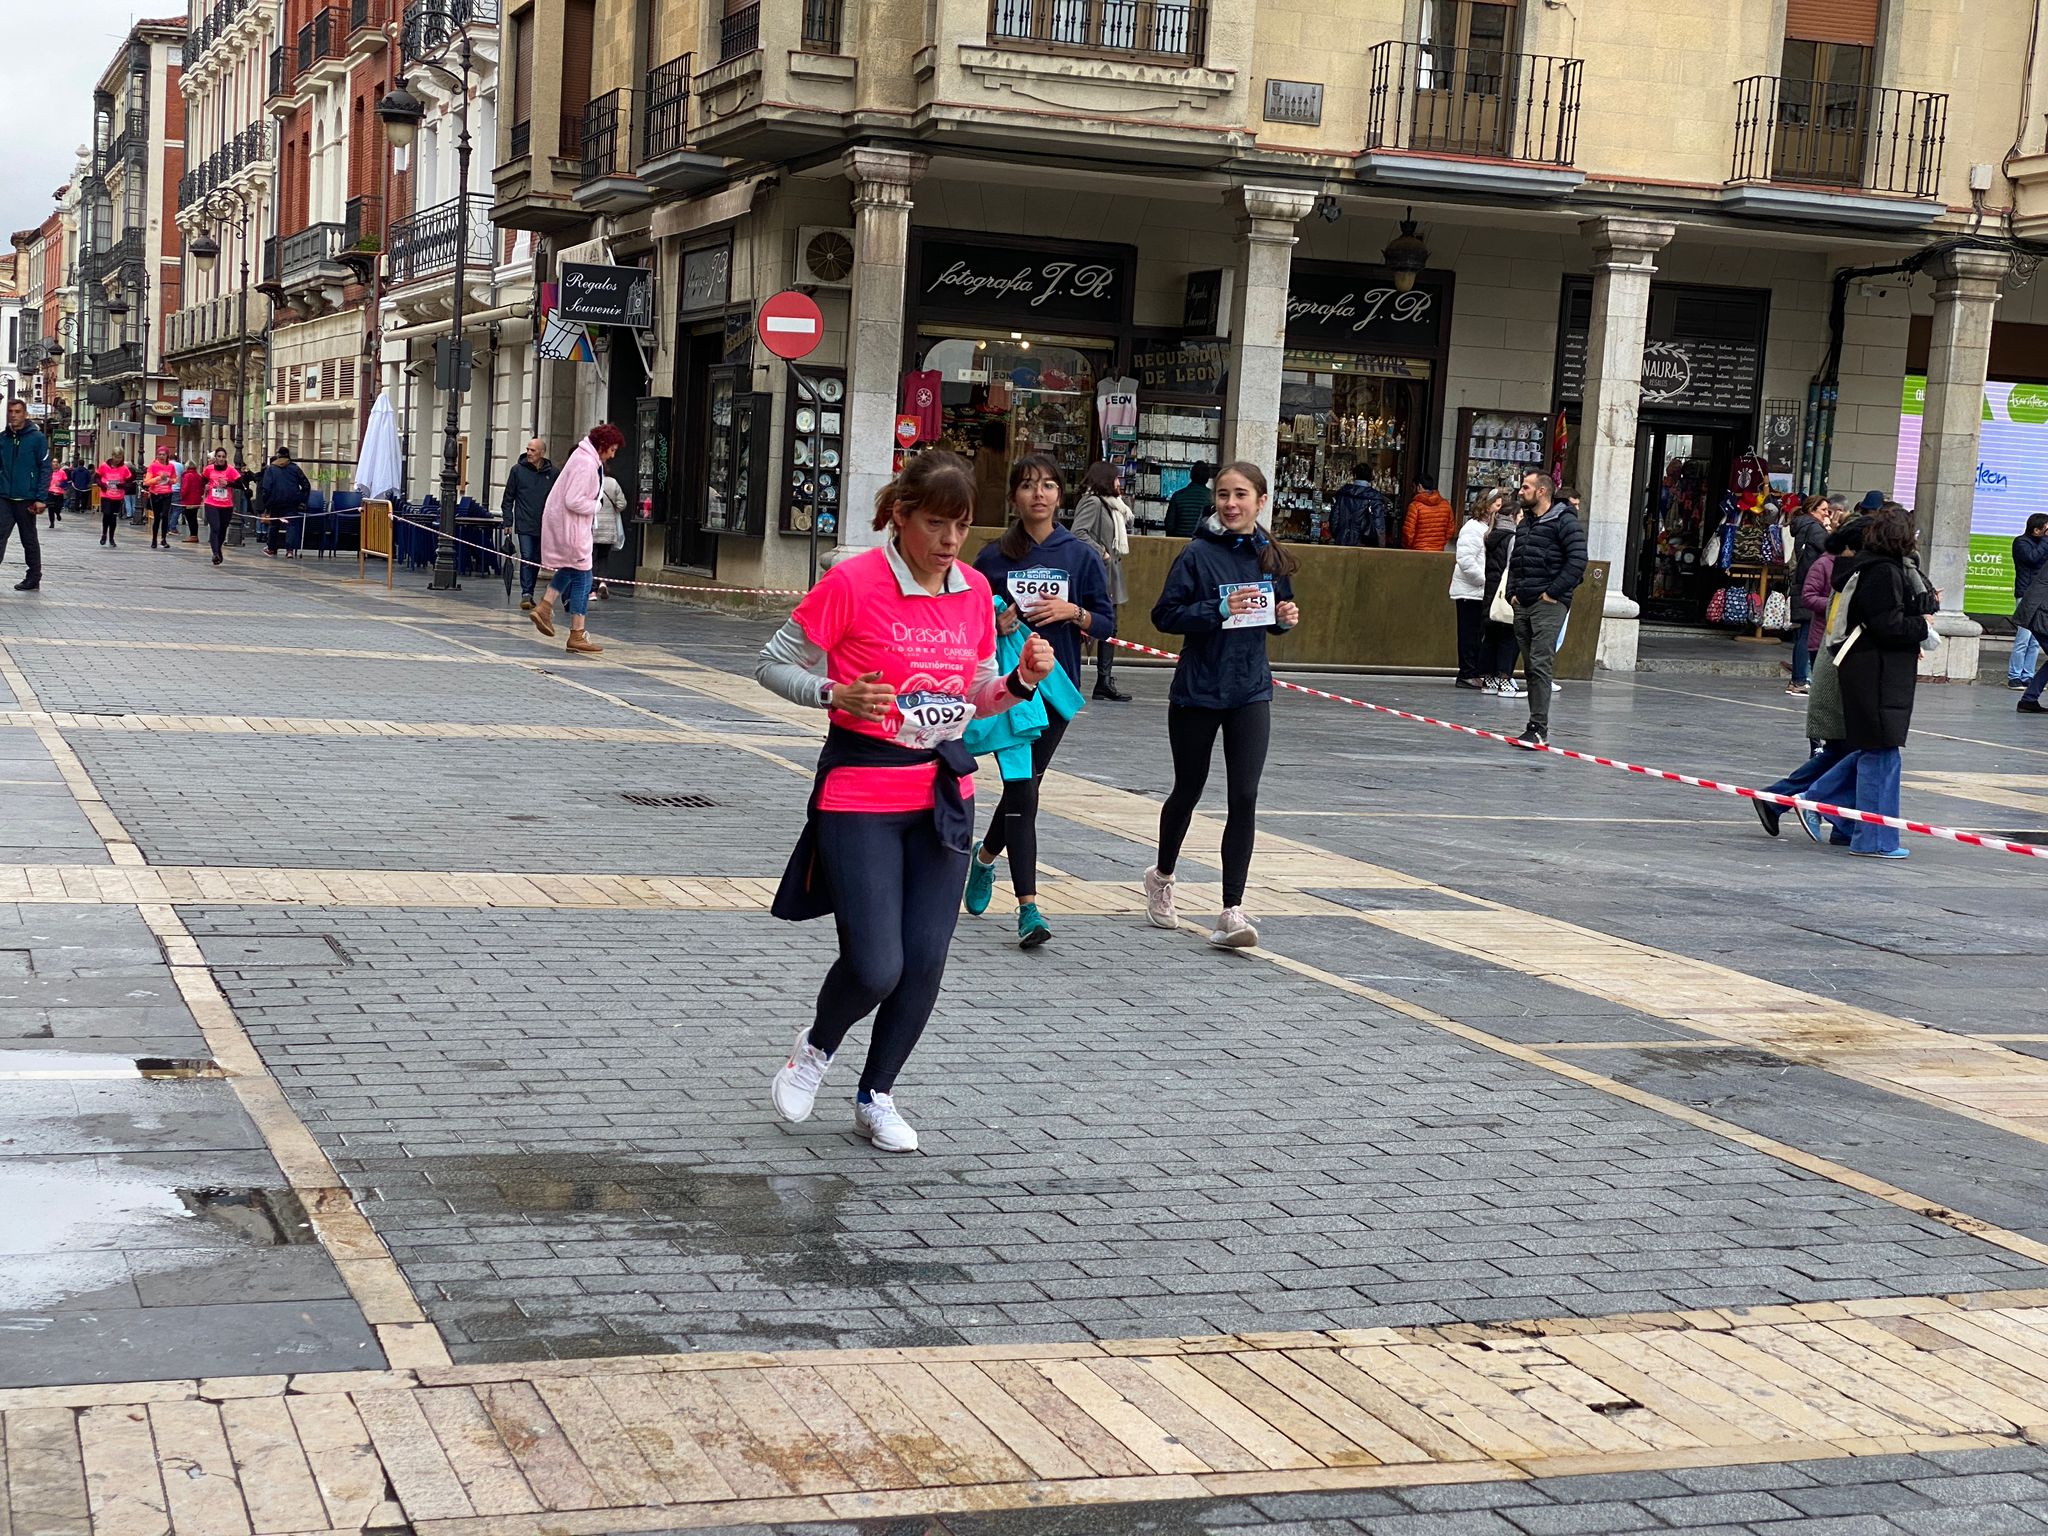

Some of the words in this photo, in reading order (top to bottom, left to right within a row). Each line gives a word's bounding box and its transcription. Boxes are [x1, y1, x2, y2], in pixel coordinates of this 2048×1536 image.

[1279, 95, 1309, 105] PLAZA
[565, 272, 618, 295] Regalos
[565, 297, 622, 316] Souvenir
[1144, 370, 1167, 385] DE
[1175, 366, 1219, 384] LEON
[1642, 359, 1678, 379] NAURA
[1974, 462, 2008, 488] leon
[1974, 552, 2003, 564] CÔTÉ
[1016, 580, 1060, 596] 5649
[913, 704, 966, 727] 1092
